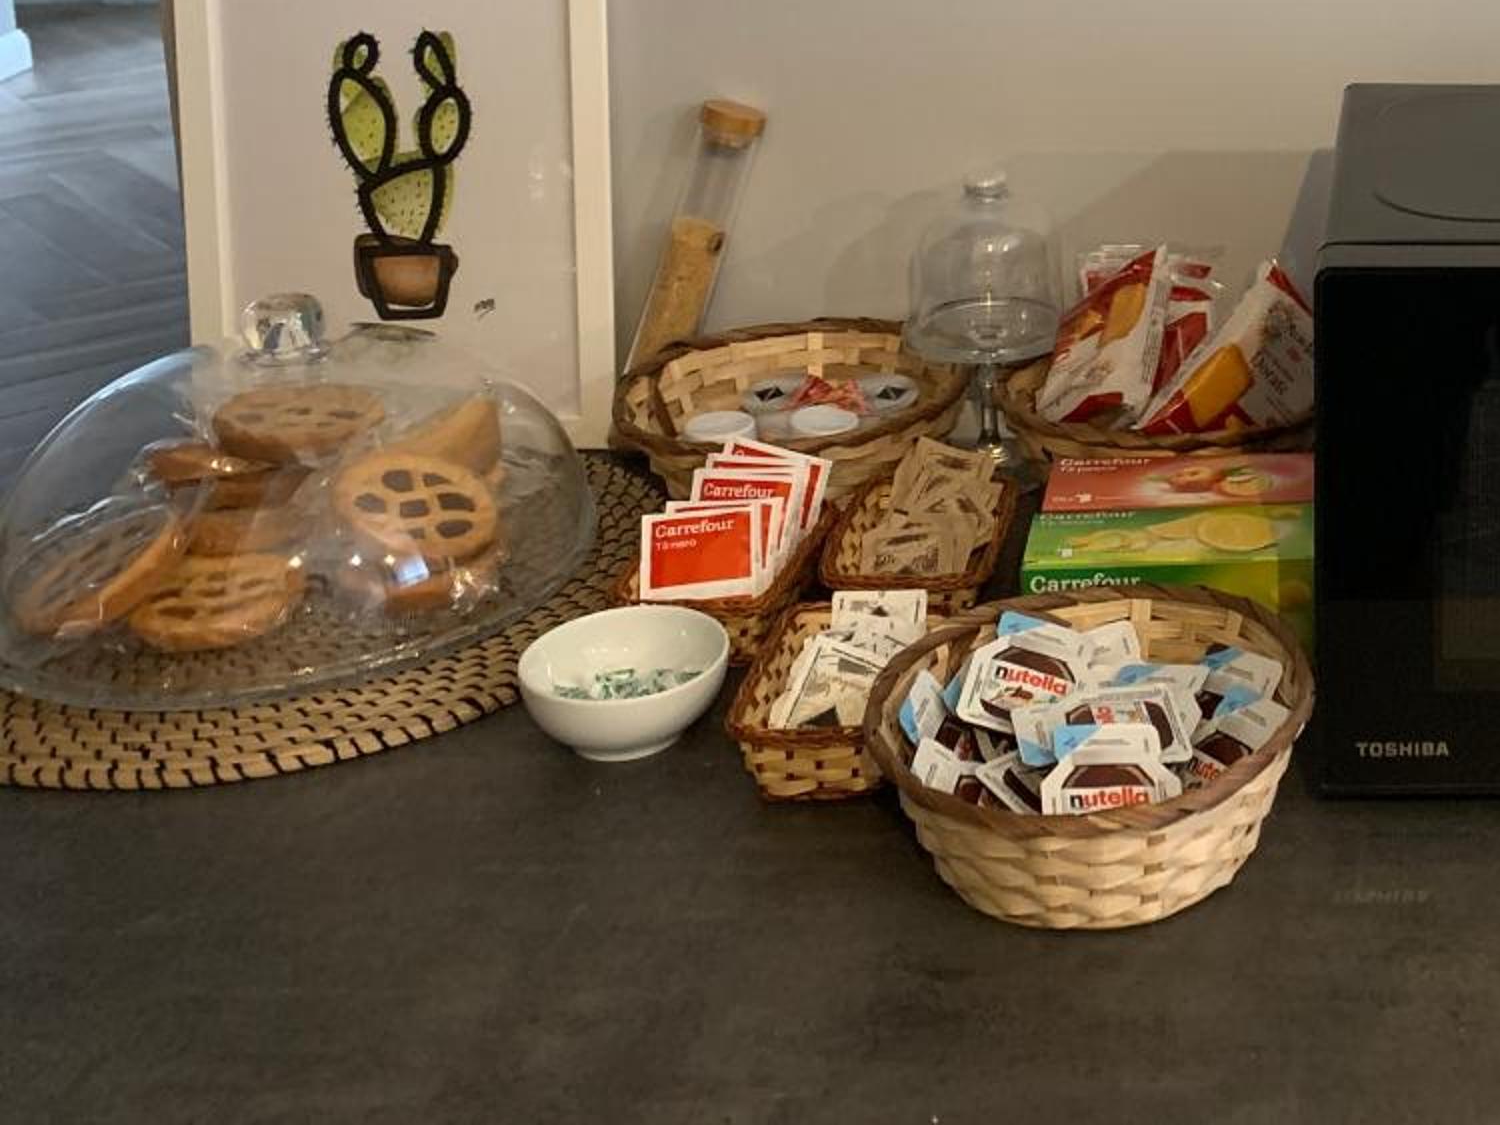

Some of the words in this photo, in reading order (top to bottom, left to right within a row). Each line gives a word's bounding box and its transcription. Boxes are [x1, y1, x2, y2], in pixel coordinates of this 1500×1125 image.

[703, 482, 775, 500] Carrefour
[655, 518, 735, 539] Carrefour
[995, 665, 1067, 696] nutella
[1355, 741, 1449, 757] TOSHIBA
[1070, 787, 1149, 808] nutella
